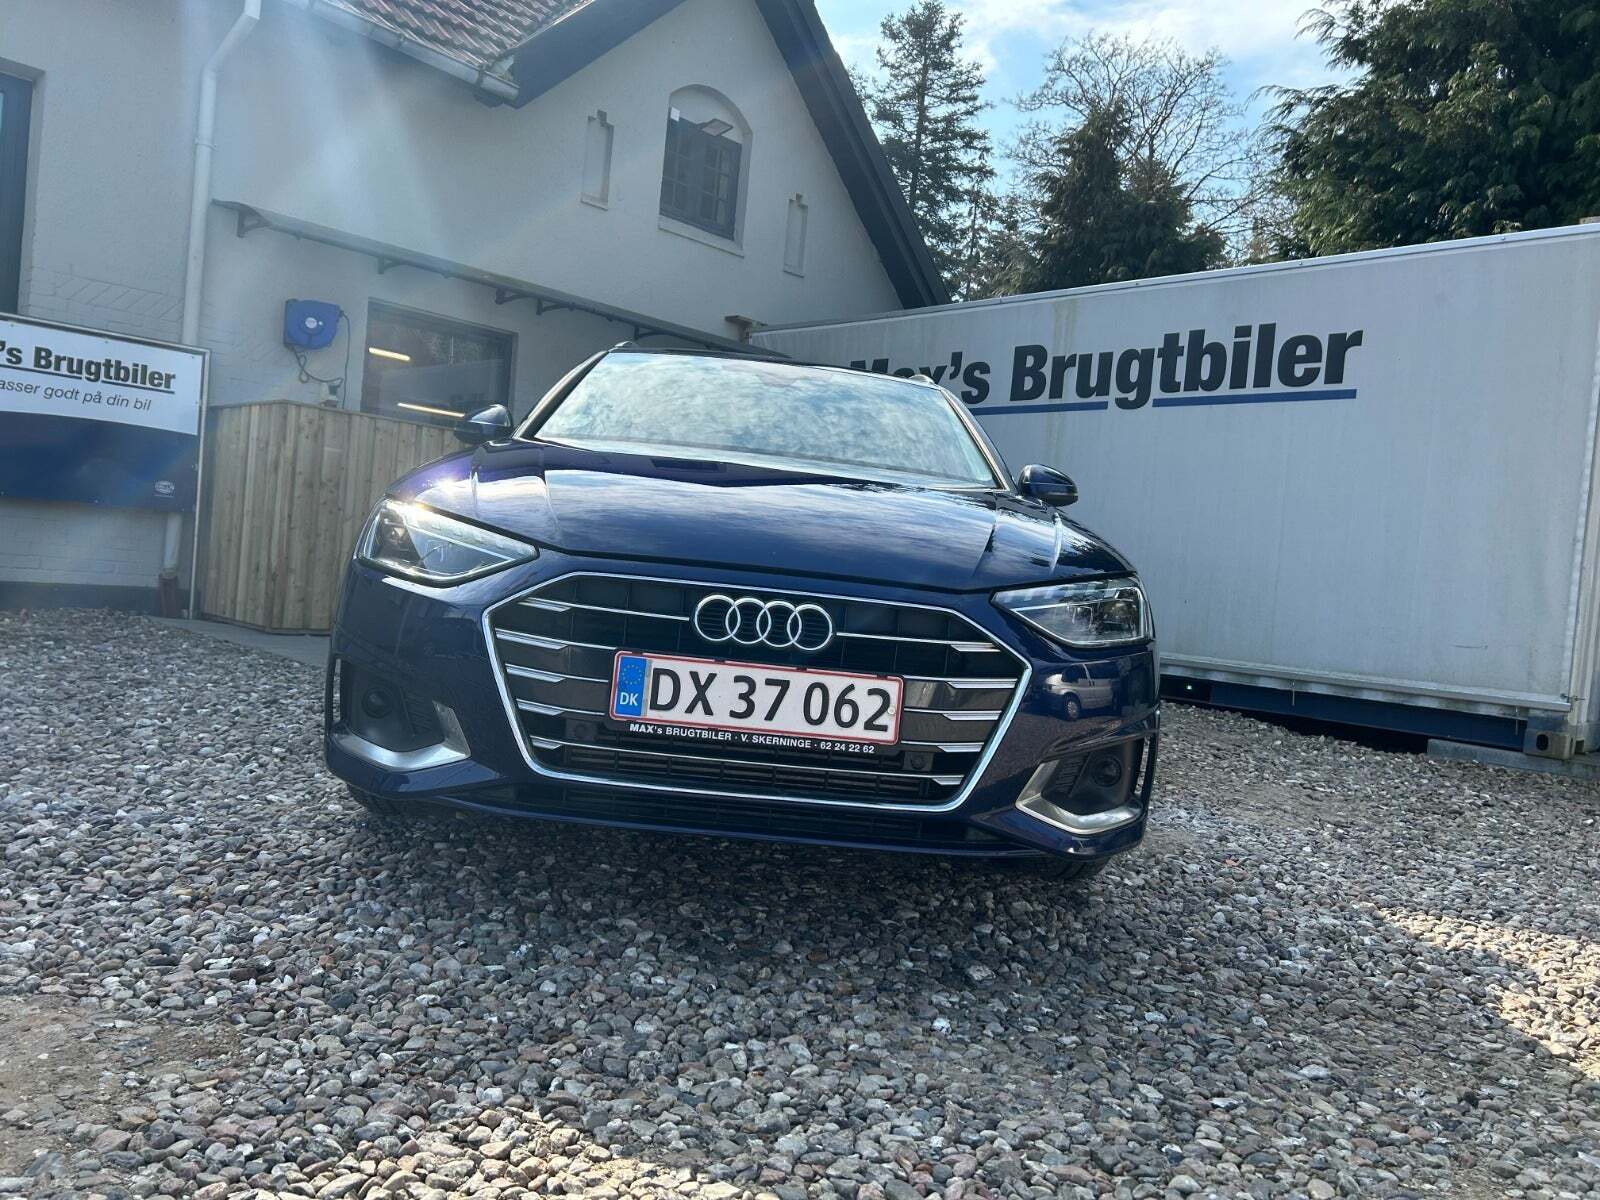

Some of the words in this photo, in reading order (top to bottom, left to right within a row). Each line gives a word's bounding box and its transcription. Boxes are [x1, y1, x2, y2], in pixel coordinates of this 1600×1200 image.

[34, 346, 176, 389] Brugtbiler
[1009, 322, 1364, 410] Brugtbiler
[43, 386, 80, 400] godt
[82, 391, 102, 405] på
[106, 393, 130, 408] din
[133, 397, 152, 411] bil
[619, 691, 639, 707] DK
[649, 667, 718, 717] DX
[729, 675, 791, 722] 37
[803, 681, 892, 733] 062
[629, 723, 663, 735] MAX's
[665, 726, 732, 741] BRUGTBILER
[740, 733, 749, 743] V.
[752, 734, 812, 749] SKERNINGE
[820, 741, 832, 750] 62
[834, 742, 846, 751] 24
[848, 744, 860, 753] 22
[862, 745, 875, 754] 62
